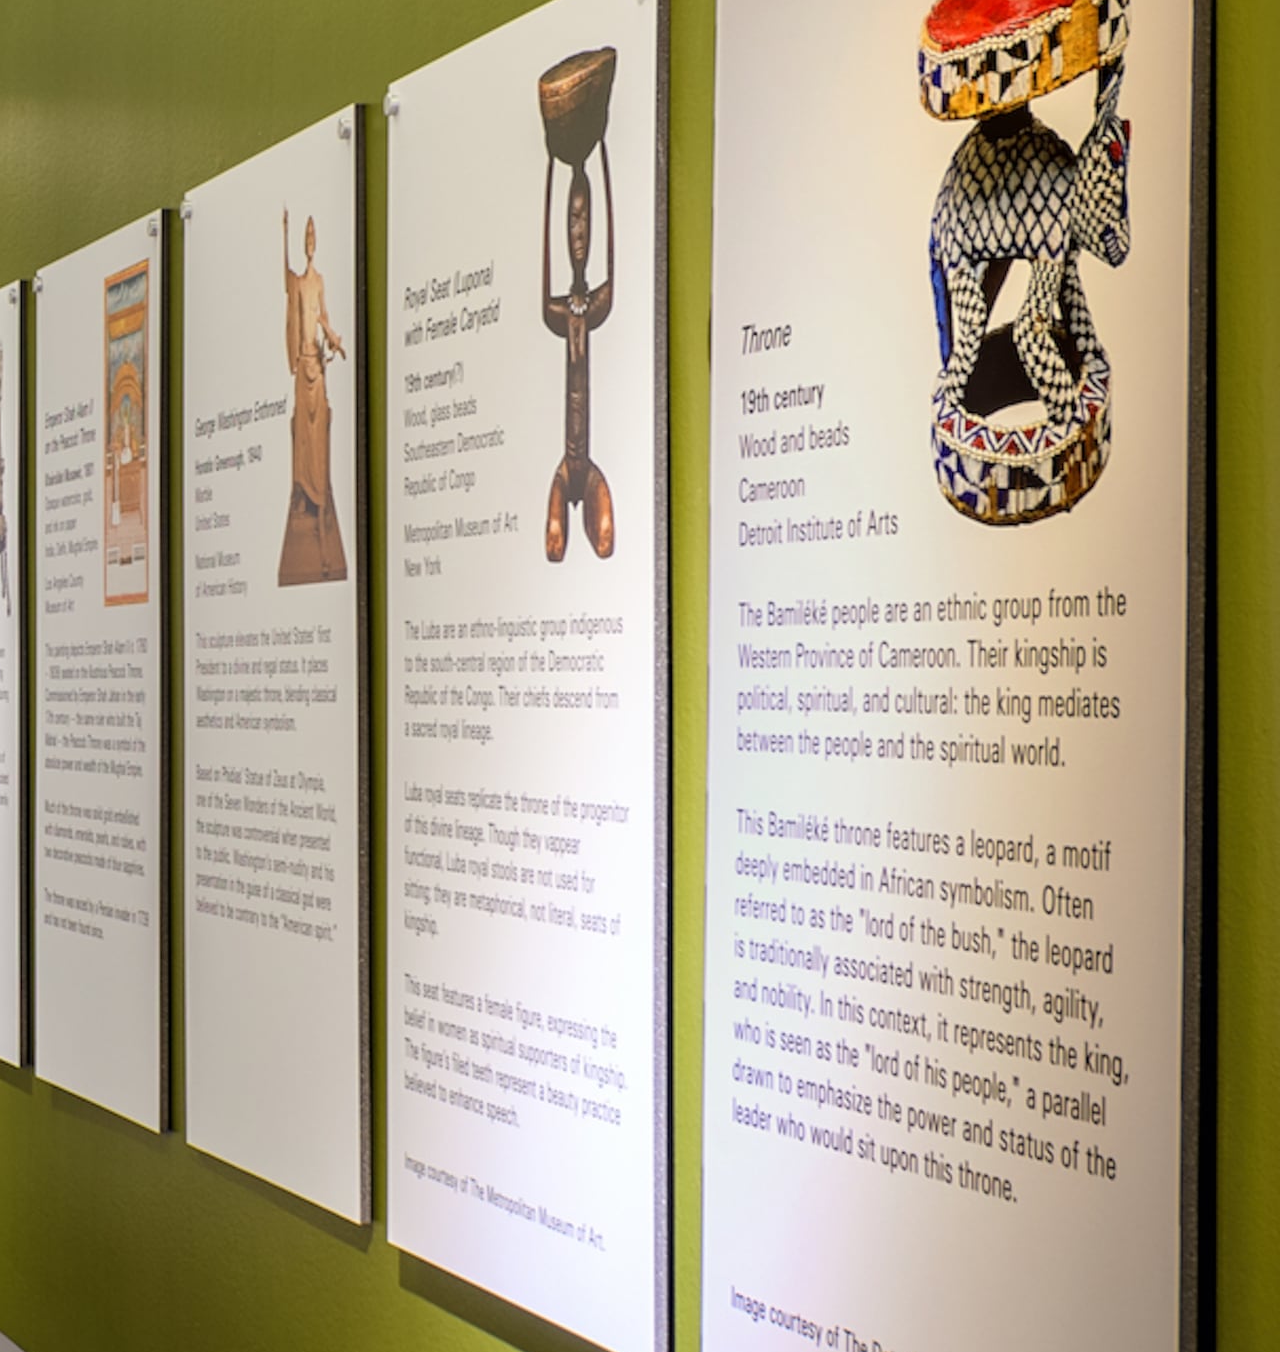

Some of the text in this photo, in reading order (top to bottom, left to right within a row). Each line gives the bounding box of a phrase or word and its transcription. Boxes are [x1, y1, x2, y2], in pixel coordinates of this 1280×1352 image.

[404, 282, 429, 313] Royal
[425, 312, 458, 342] Female
[741, 323, 792, 356] Throne
[740, 384, 825, 416] 19th century
[738, 420, 850, 460] Wood and beads
[738, 476, 805, 505] Cameroon
[404, 520, 453, 546] Metropolitan
[454, 517, 491, 538] Museum
[491, 512, 502, 535] of
[738, 509, 899, 548] Detroit Institute of Arts
[738, 601, 763, 628] The
[831, 597, 880, 631] people
[884, 602, 909, 624] are
[912, 601, 932, 623] an
[936, 592, 988, 623] ethnic
[992, 596, 1042, 629] group
[1047, 587, 1091, 620] from
[1095, 585, 1127, 618] the
[737, 636, 1108, 676] Western Province of Cameroon. Their kingship is
[737, 685, 1121, 725] political, spiritual, and cultural: the king mediates
[737, 726, 1066, 769] between the people and the spiritual world.
[736, 808, 764, 836] This
[833, 818, 882, 849] throne
[886, 821, 951, 857] features
[955, 834, 966, 858] a
[970, 829, 1040, 870] leopard,
[1045, 843, 1057, 867] a
[1062, 840, 1112, 872] motif
[735, 851, 1094, 921] deeply embedded in African symbolism. Often
[734, 892, 1114, 978] referred to as the "lord of the bush," the leopard
[734, 932, 1104, 1031] is traditionally associated with strength, agility,
[731, 1286, 767, 1324] Image
[769, 1306, 823, 1348] courtesy
[825, 1325, 840, 1350] of
